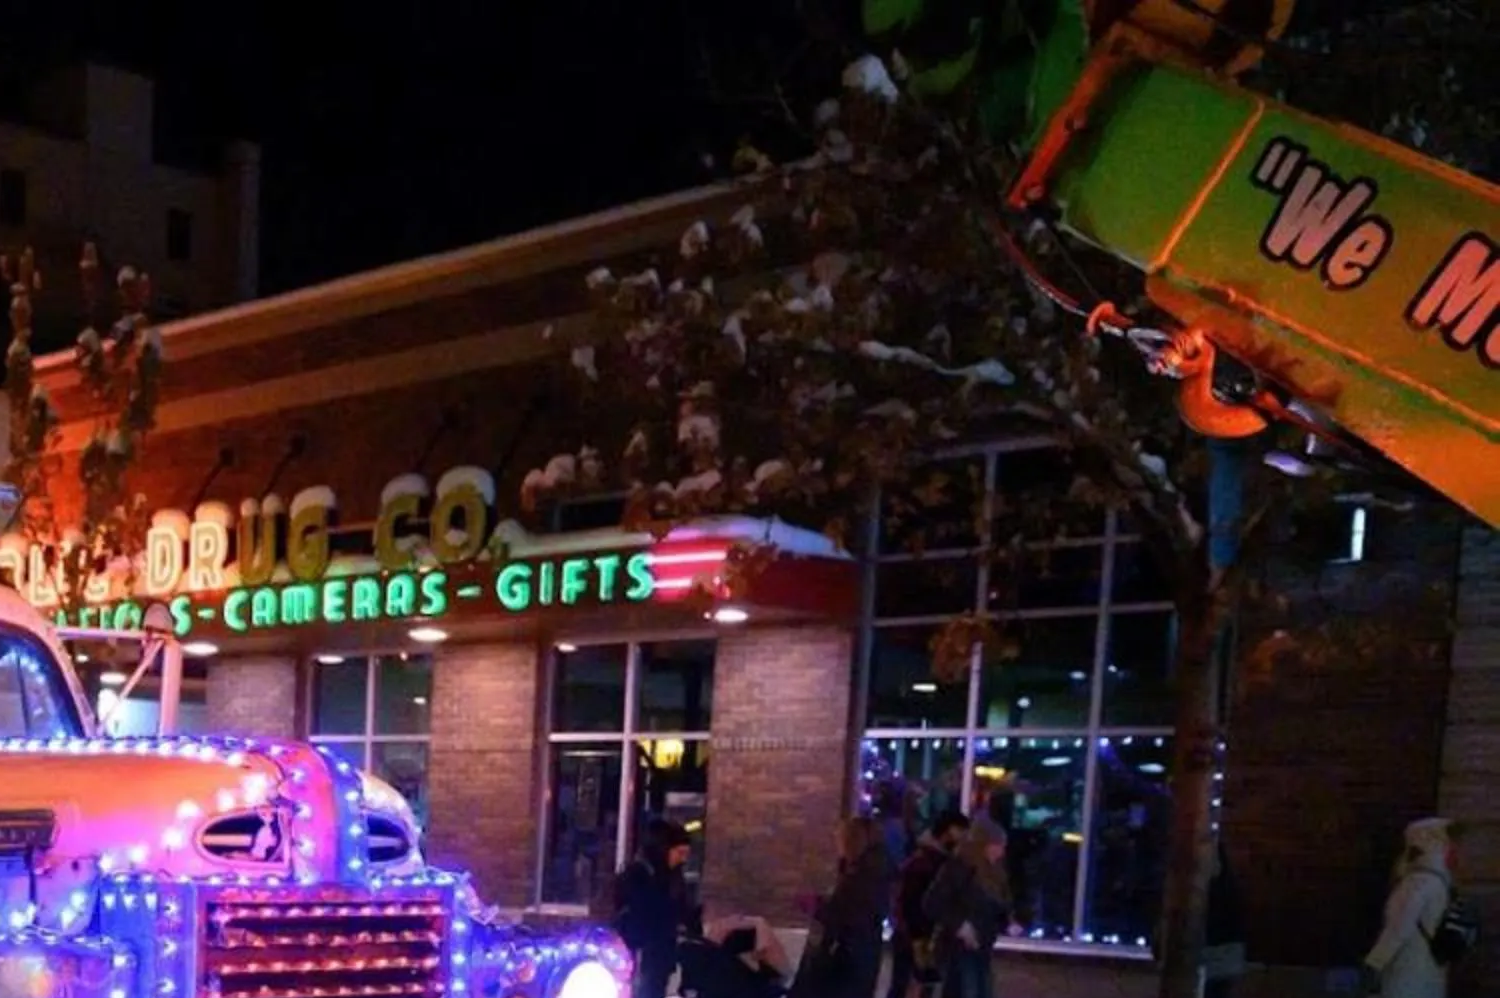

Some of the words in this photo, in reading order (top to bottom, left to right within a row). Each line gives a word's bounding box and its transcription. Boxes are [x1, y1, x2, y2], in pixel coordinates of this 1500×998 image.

[1406, 231, 1499, 369] M
[145, 503, 329, 596] DRUG
[496, 552, 654, 611] GIFTS
